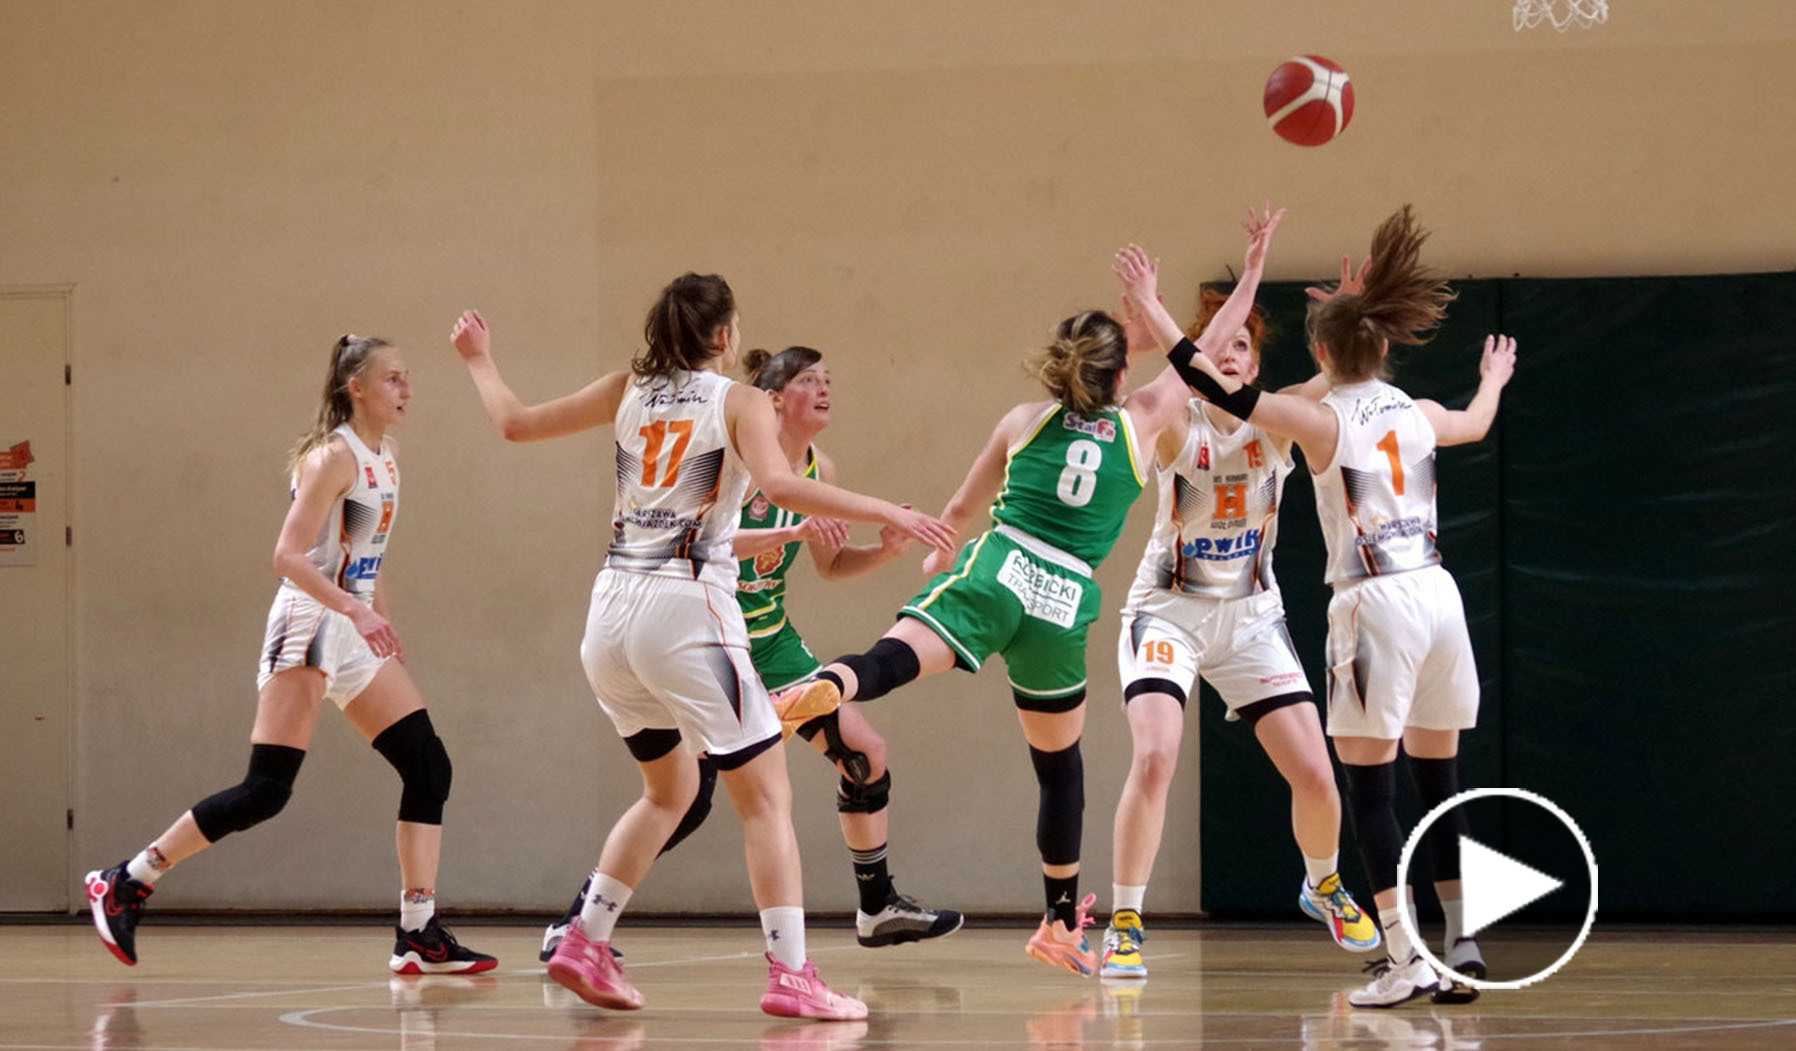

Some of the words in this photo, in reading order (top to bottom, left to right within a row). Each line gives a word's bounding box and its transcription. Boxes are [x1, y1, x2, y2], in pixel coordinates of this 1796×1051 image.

[638, 420, 694, 487] 17
[1056, 439, 1102, 507] 8
[1376, 430, 1405, 496] 1
[1142, 639, 1175, 665] 19
